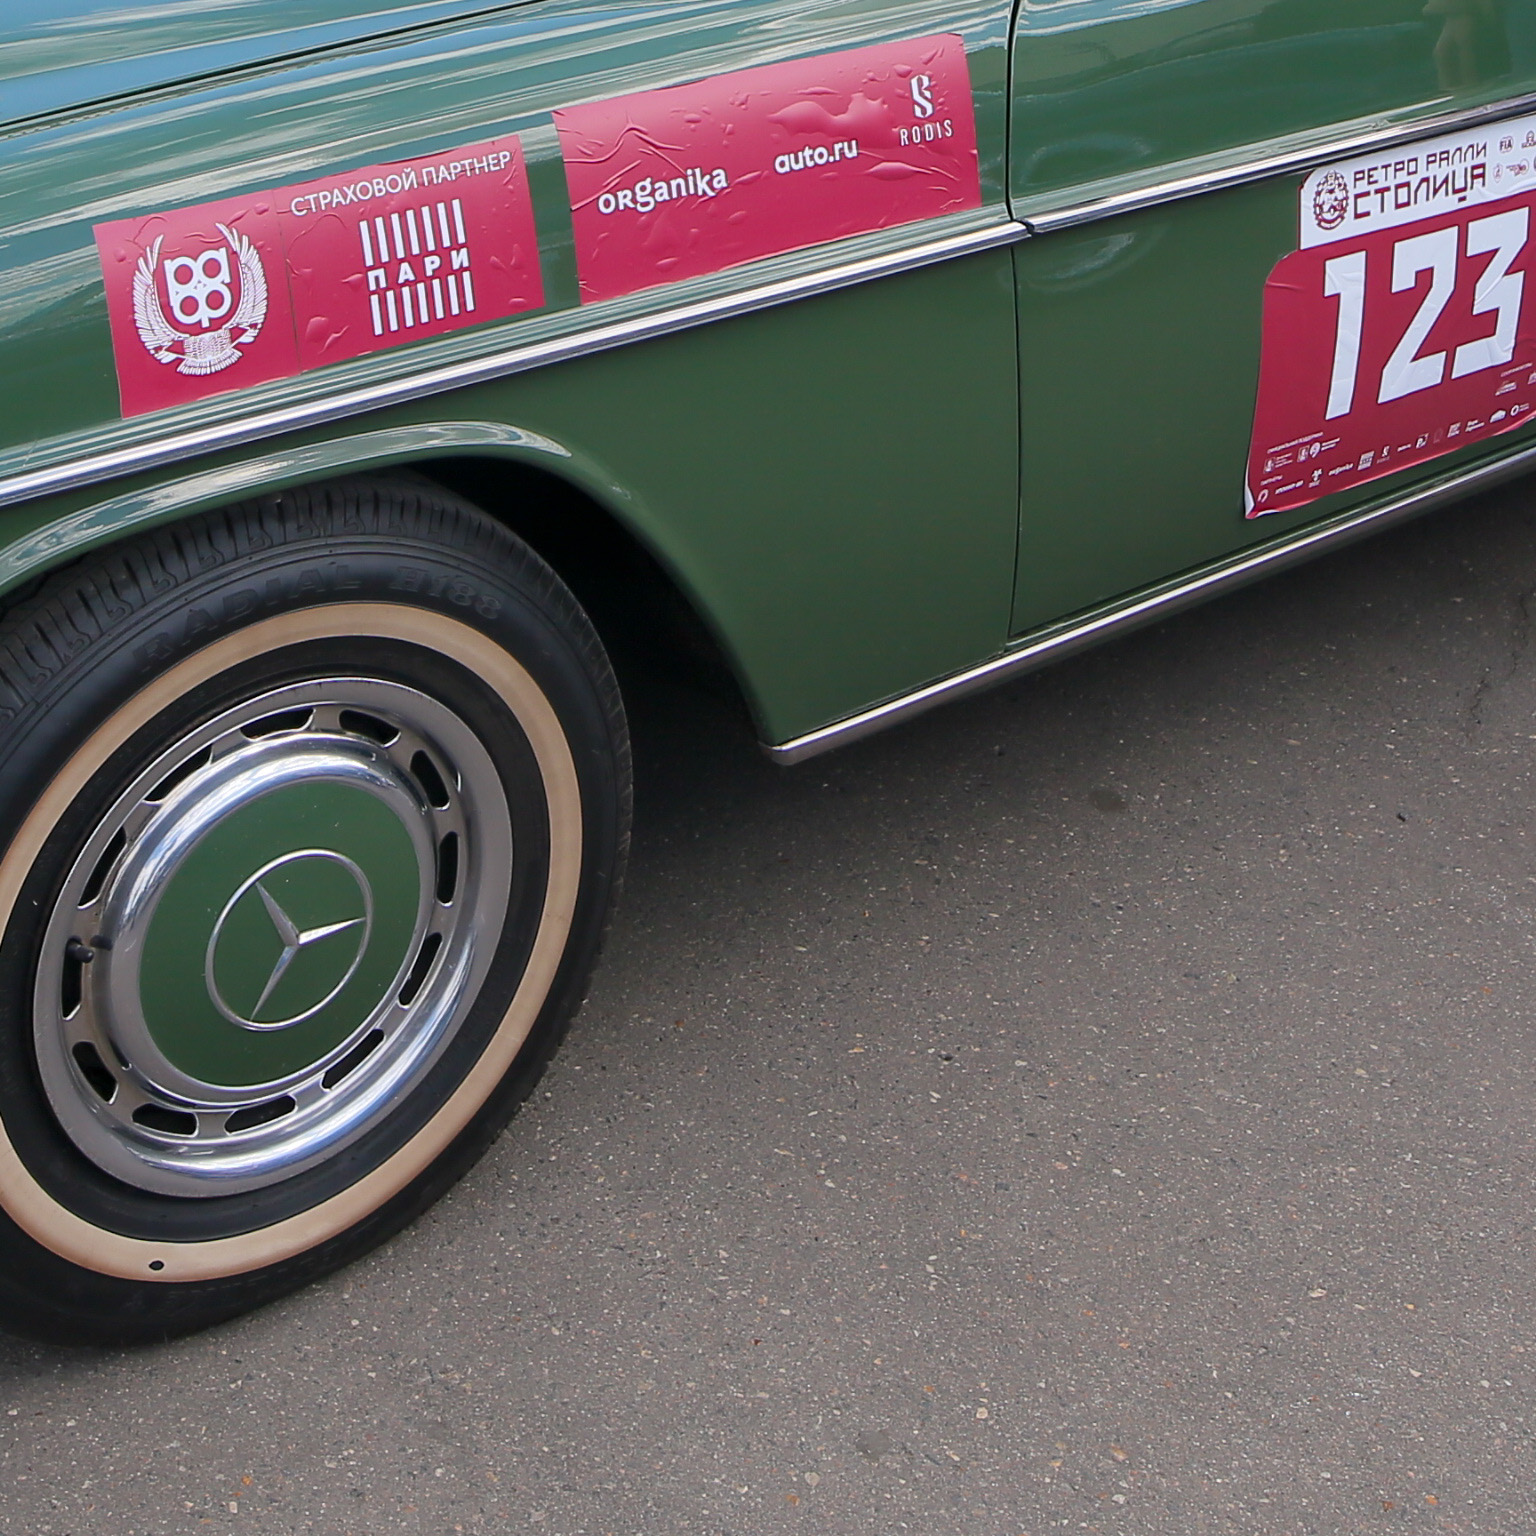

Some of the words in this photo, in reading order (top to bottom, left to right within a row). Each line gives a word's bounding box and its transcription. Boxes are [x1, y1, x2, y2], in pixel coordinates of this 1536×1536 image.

[773, 139, 859, 175] auto.ru
[899, 120, 954, 147] RODIS
[290, 166, 419, 217] СТРАХОВОЙ
[422, 150, 512, 185] ПАРТНЕР
[1353, 157, 1419, 189] РЕТРО
[1425, 141, 1488, 172] РАЛЛИ
[597, 167, 728, 215] organika
[1353, 162, 1486, 220] СТОЛИЦА
[367, 247, 471, 292] ПАРИ
[1323, 206, 1531, 421] 123
